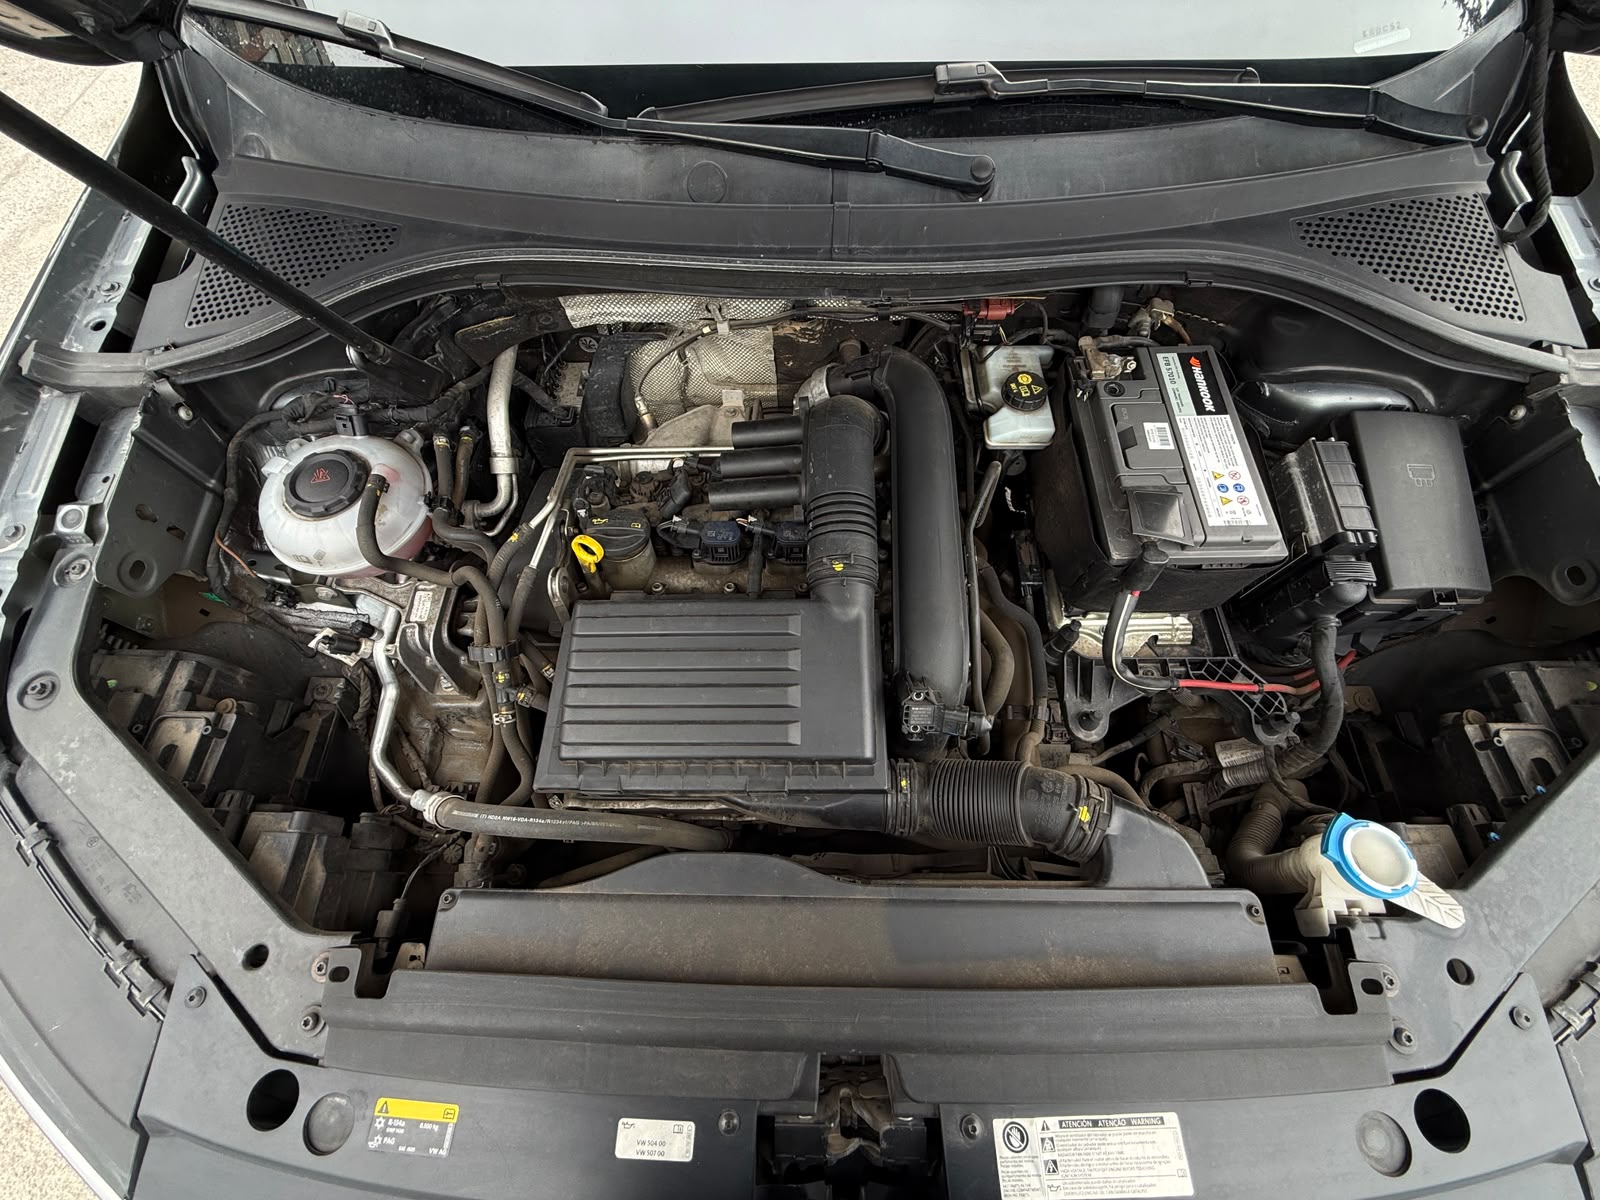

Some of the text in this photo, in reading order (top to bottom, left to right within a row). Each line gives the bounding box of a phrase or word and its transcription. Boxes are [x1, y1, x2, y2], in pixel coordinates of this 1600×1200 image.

[1166, 367, 1176, 384] 57010
[1062, 1117, 1161, 1128] ATENCIÓN ATENÇÃO WARNING
